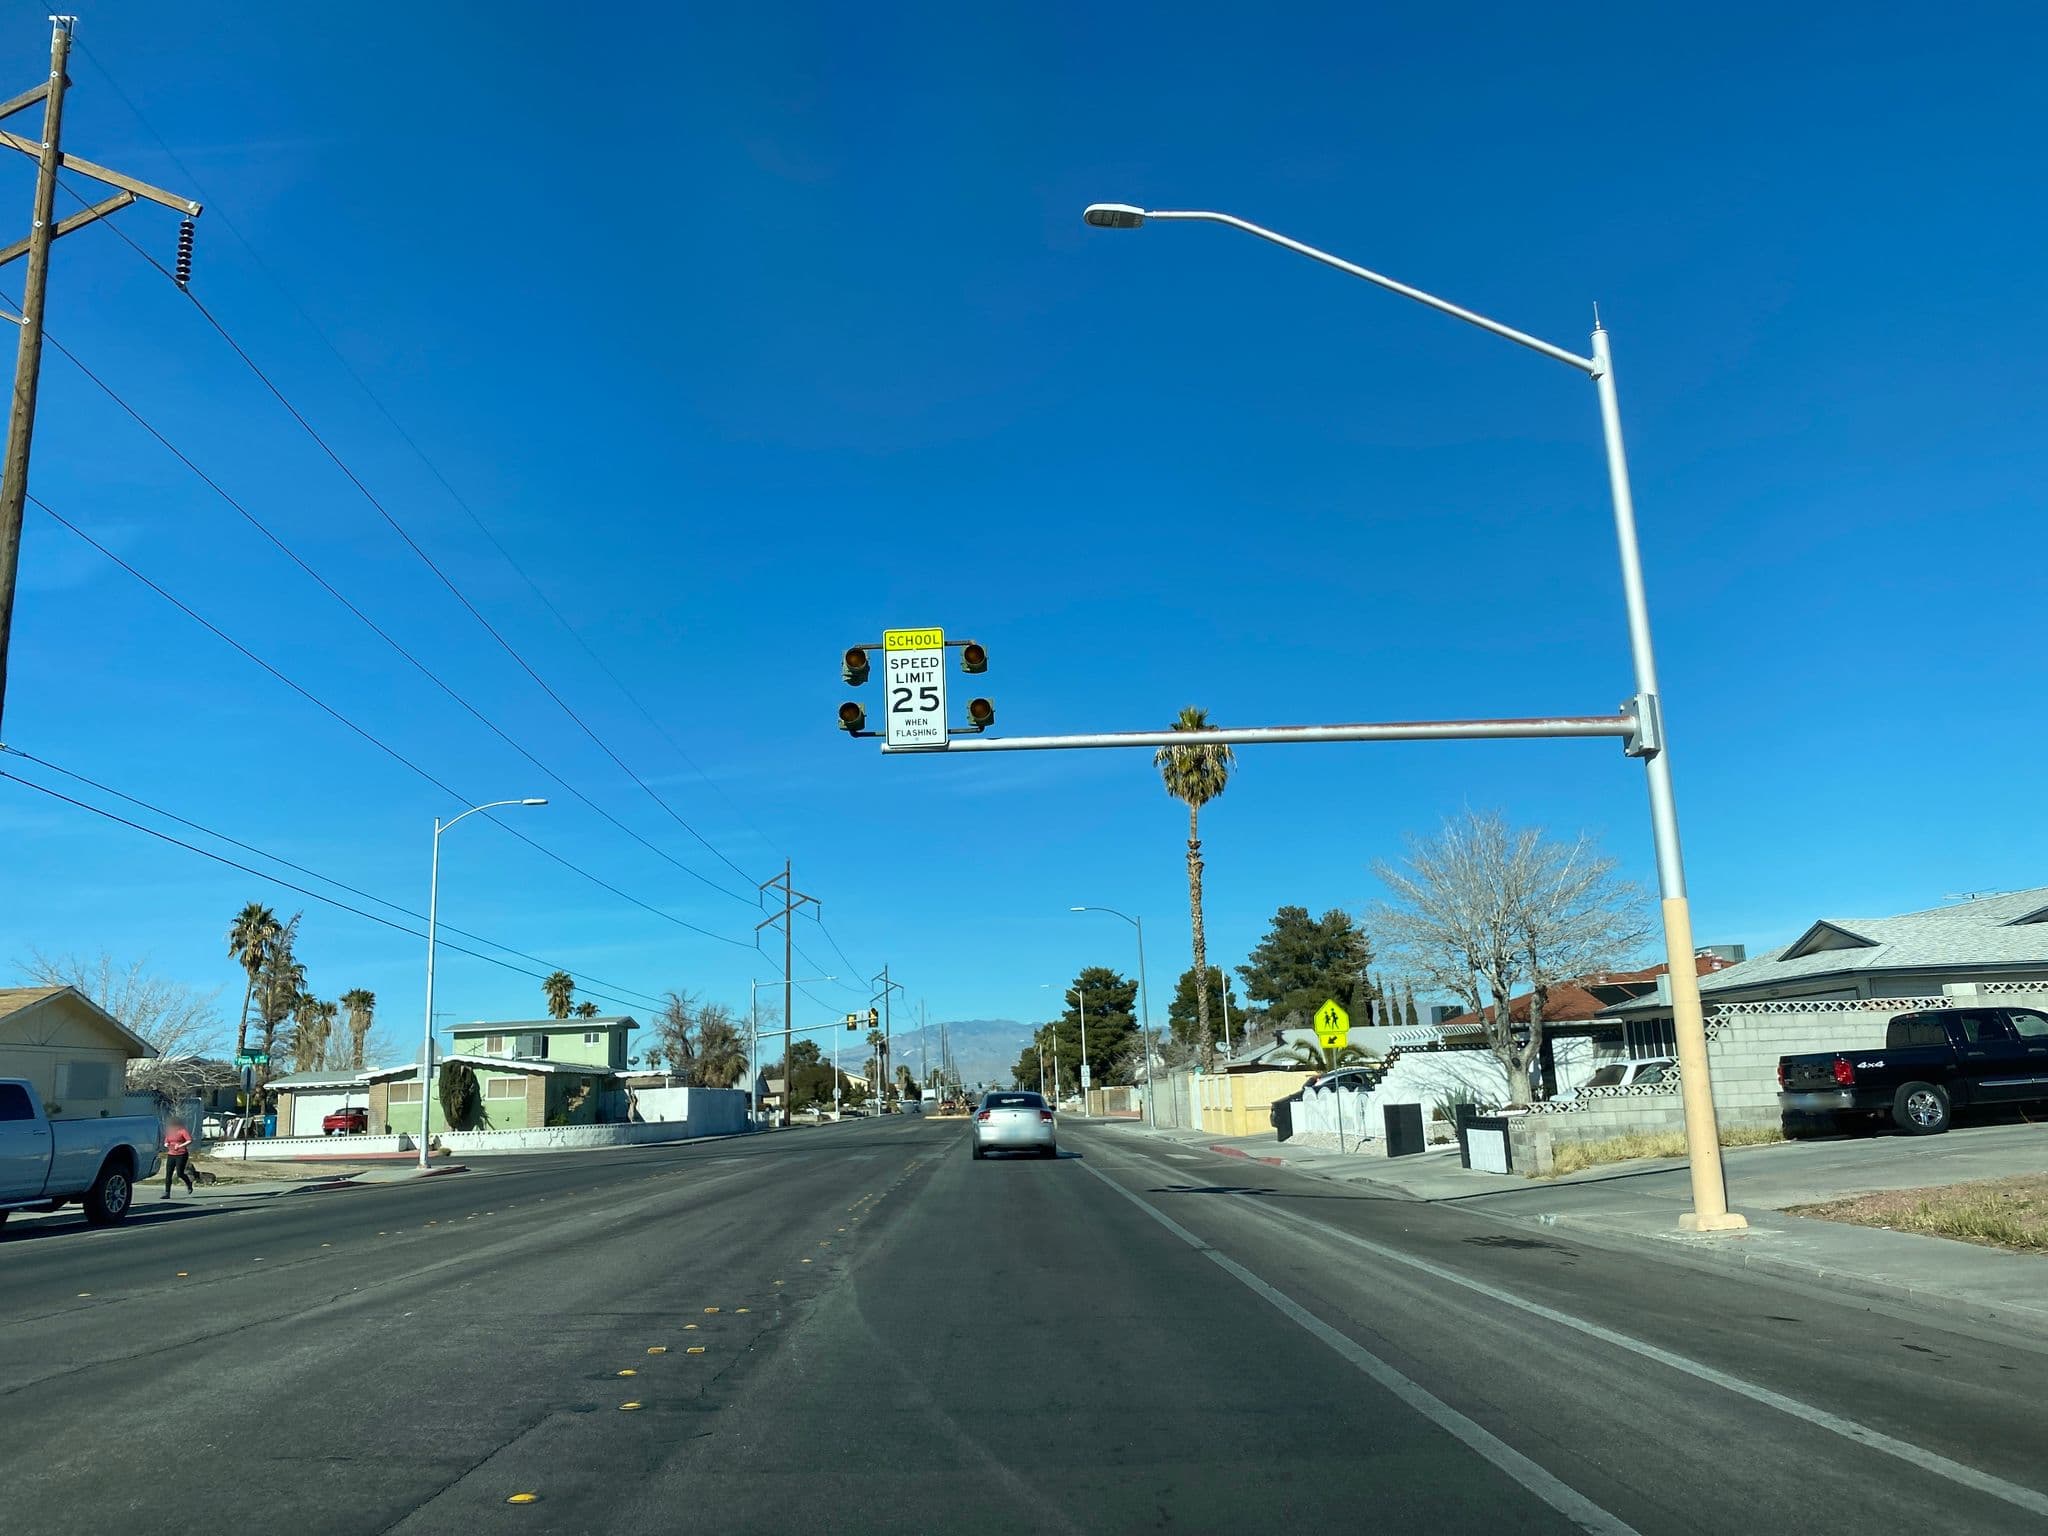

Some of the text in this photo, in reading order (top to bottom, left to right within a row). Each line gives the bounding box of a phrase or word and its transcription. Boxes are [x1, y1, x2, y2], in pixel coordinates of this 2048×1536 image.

[888, 634, 940, 646] SCHOOL
[890, 657, 939, 669] SPEED
[896, 672, 934, 683] LIMIT
[892, 686, 940, 713] 25
[904, 718, 928, 726] WHEN
[896, 728, 938, 737] FLASHING
[1857, 1060, 1885, 1068] 4x4
